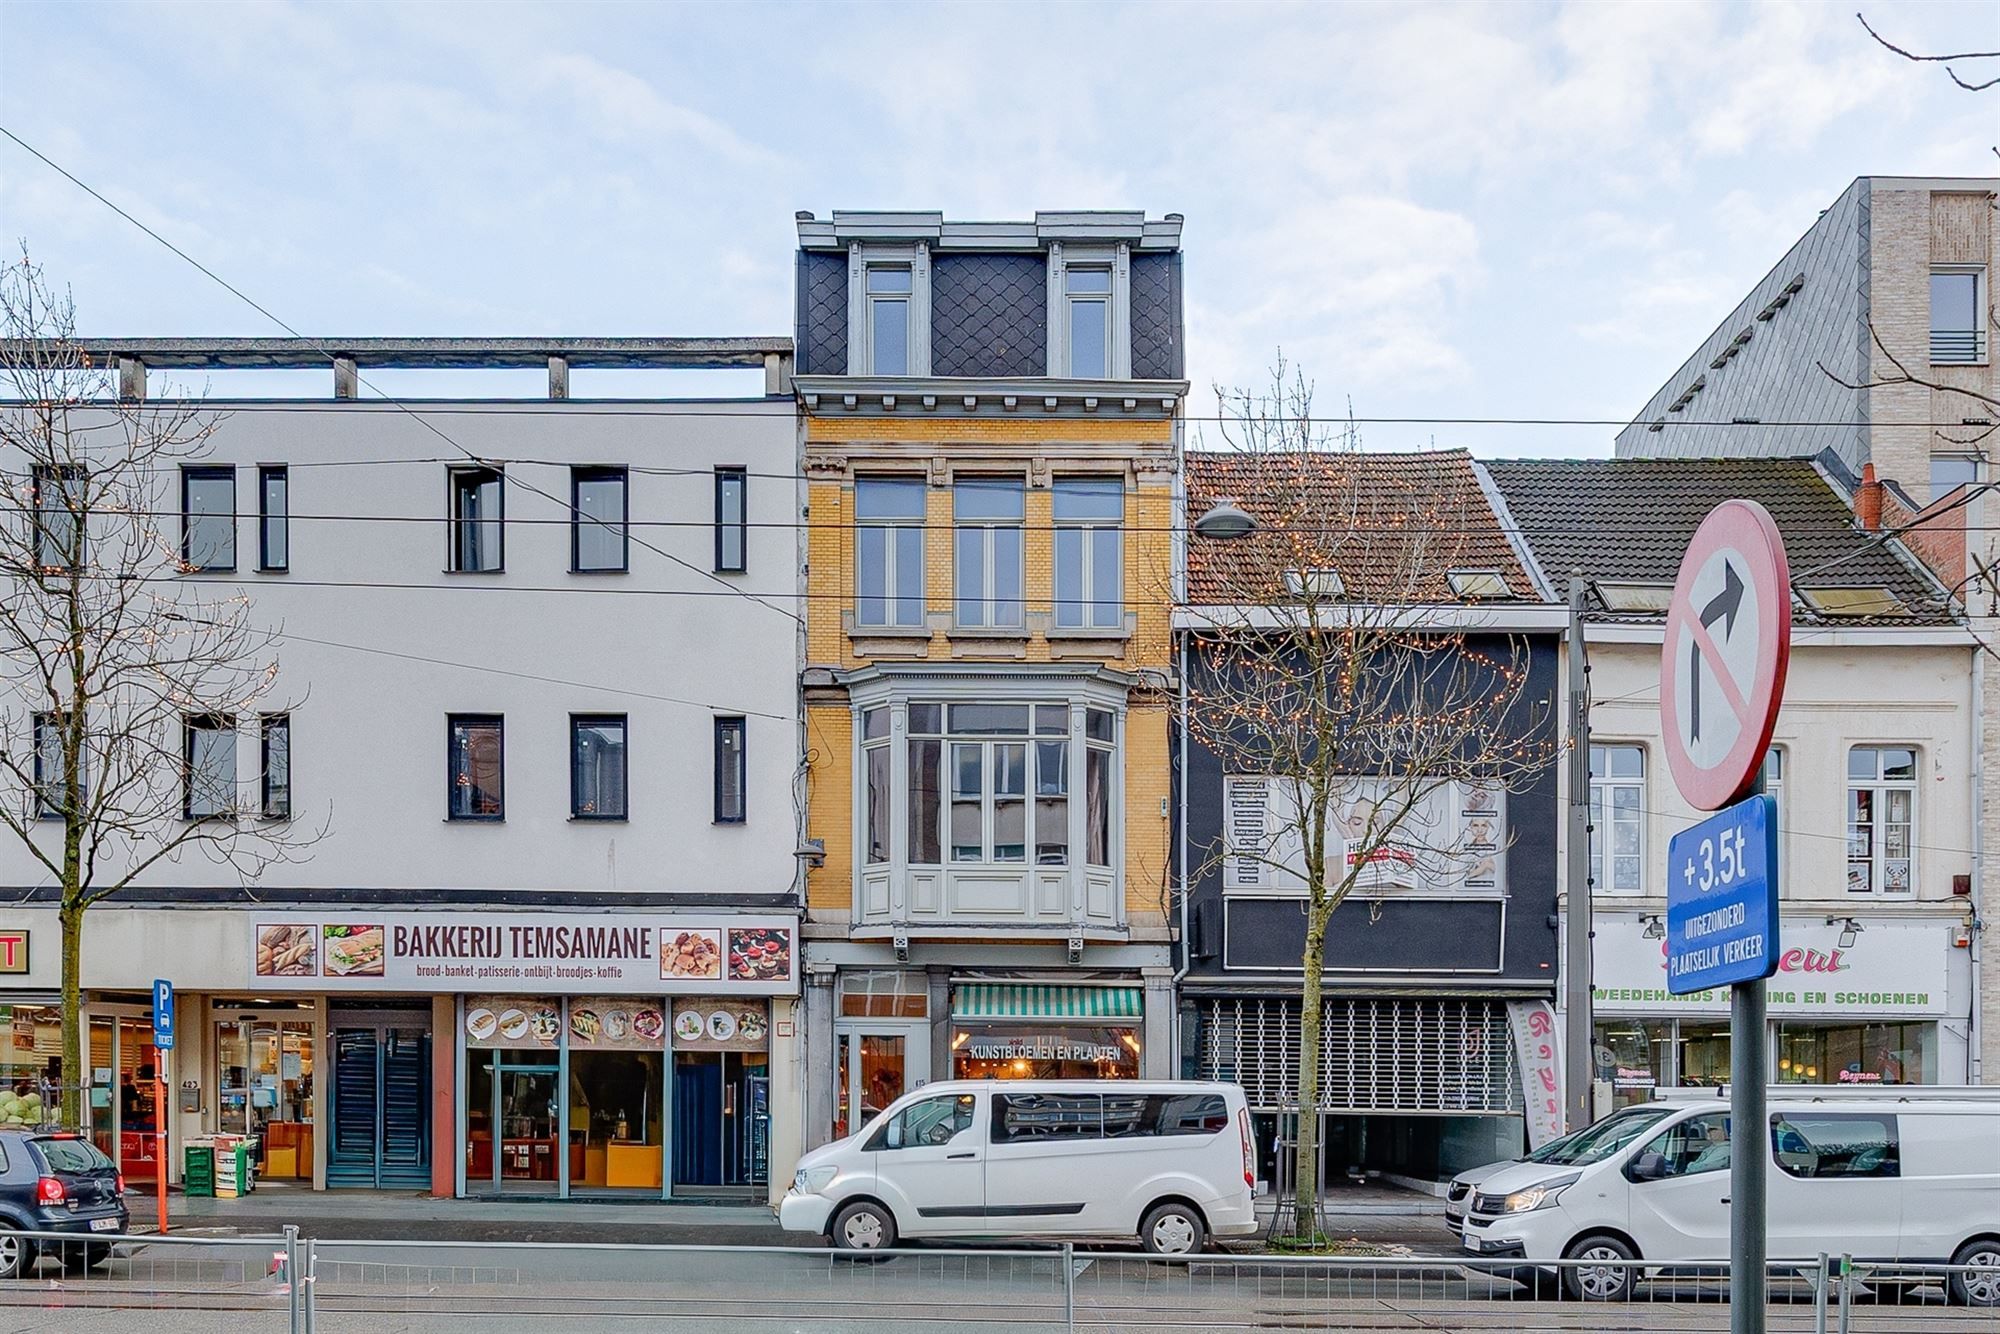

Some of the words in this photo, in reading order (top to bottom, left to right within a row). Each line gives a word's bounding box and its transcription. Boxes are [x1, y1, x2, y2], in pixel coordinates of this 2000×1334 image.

[1685, 902, 1745, 940] UITGEZONDERD
[394, 925, 502, 959] BAKKERIJ
[509, 926, 652, 959] TEMSAMANE
[1670, 945, 1720, 977] PLAATSELIJK
[1724, 935, 1763, 965] VERKEER
[160, 984, 169, 1011] P
[1592, 988, 1713, 1002] WEEDEHANDS
[1721, 990, 1796, 1003] KING
[1803, 992, 1827, 1004] EN
[1834, 992, 1929, 1005] SCHOENEN
[971, 1044, 1055, 1060] KUNSTBLOEMEN
[1057, 1045, 1071, 1060] EN
[1074, 1046, 1121, 1061] PLANTEN
